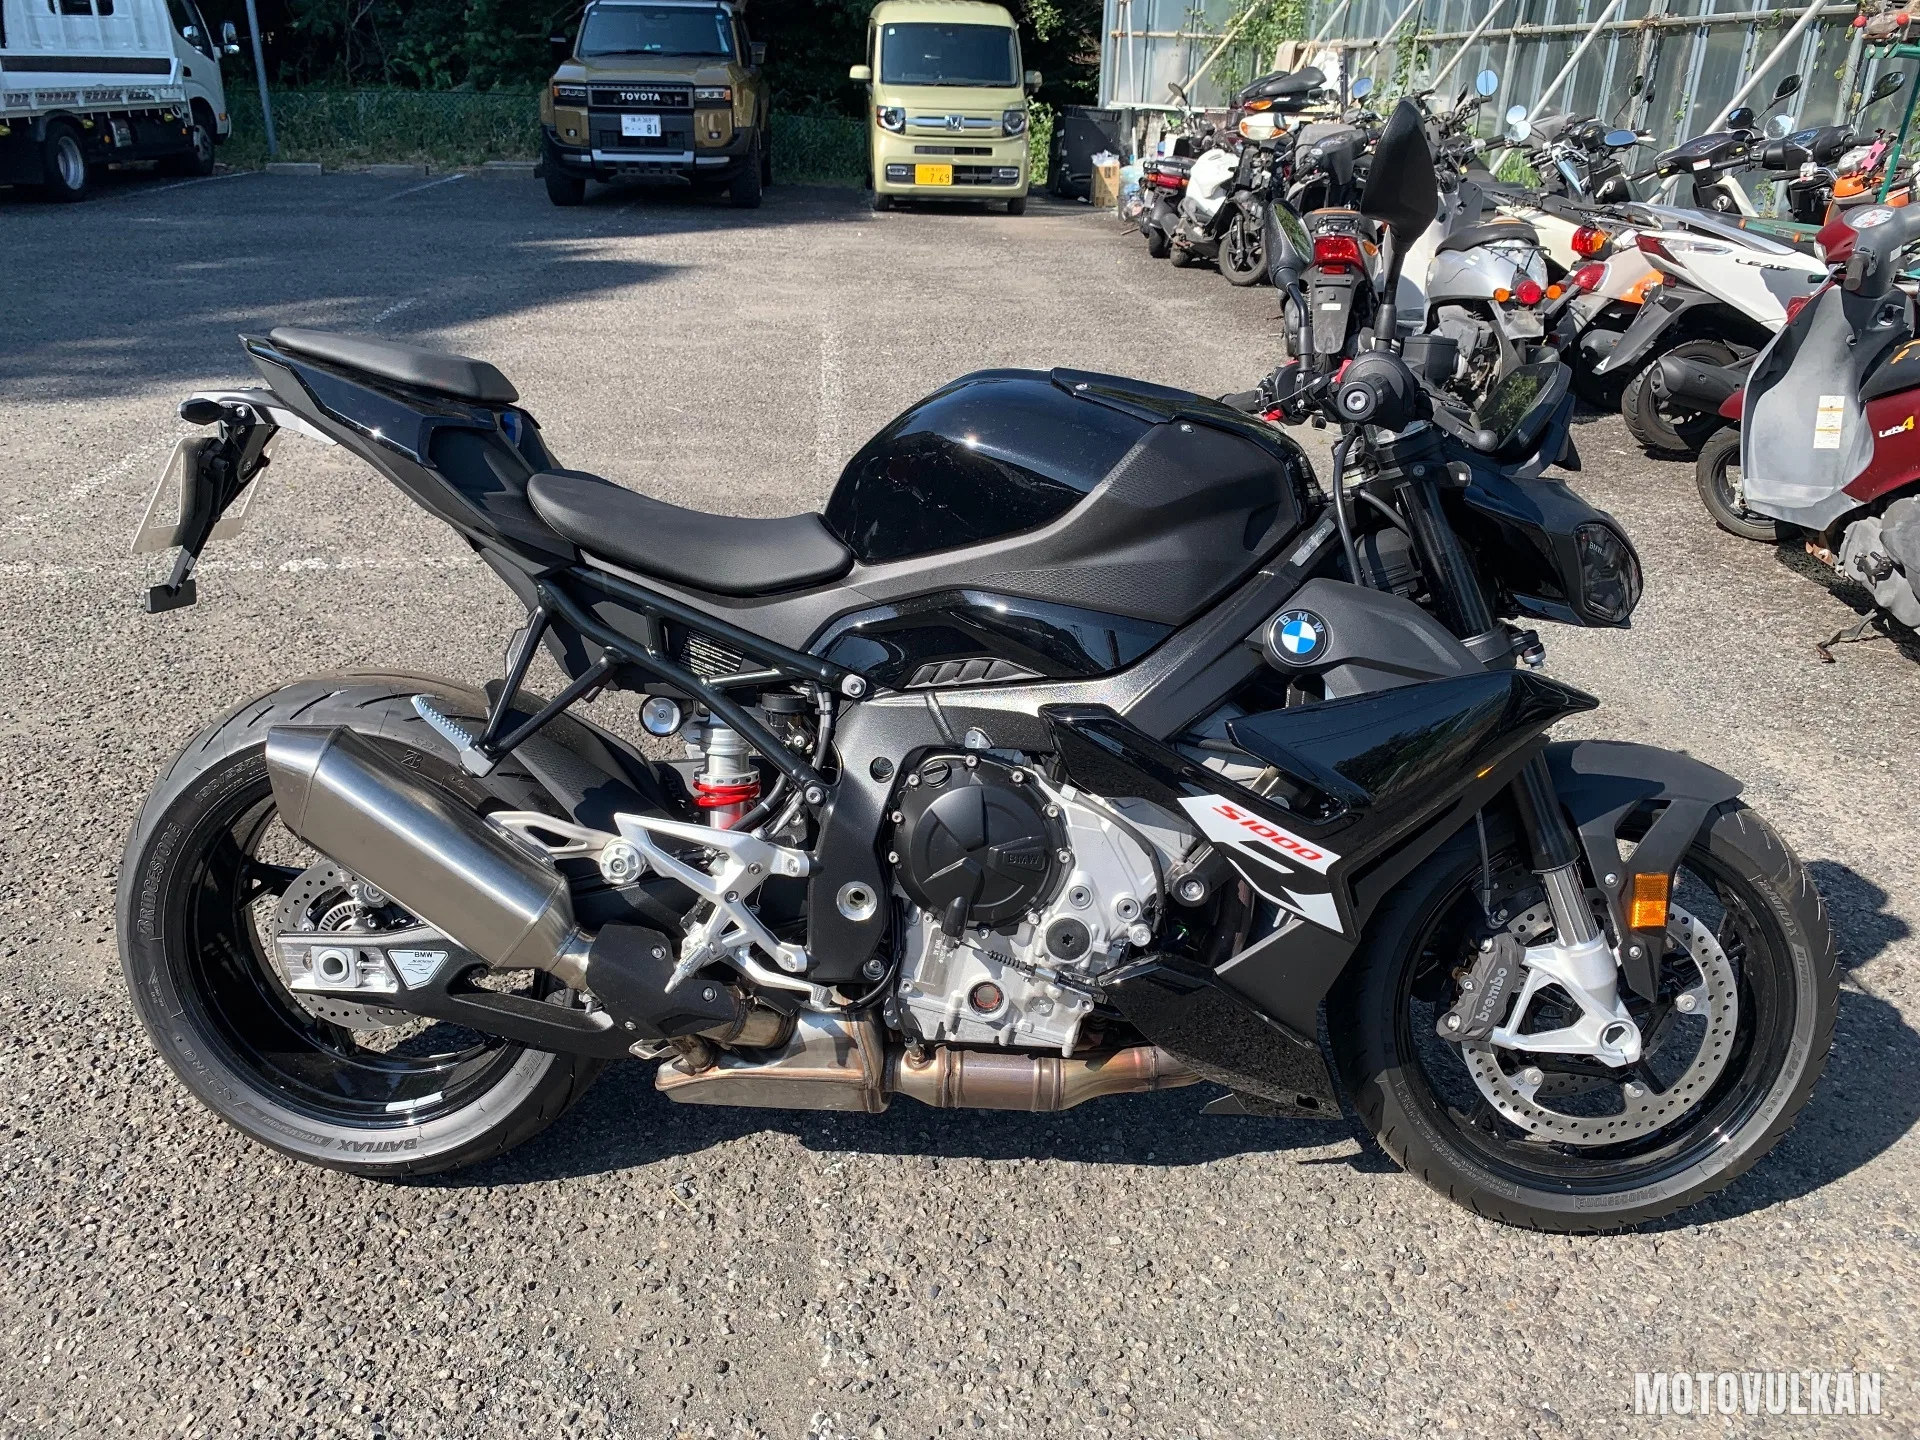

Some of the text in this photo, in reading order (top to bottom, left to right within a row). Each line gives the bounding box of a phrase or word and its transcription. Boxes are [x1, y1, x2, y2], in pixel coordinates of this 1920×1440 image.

[620, 91, 660, 101] TOYOTA
[1588, 541, 1604, 556] BMW
[1279, 611, 1325, 634] BMW
[1211, 805, 1324, 860] S1000
[1008, 853, 1040, 866] BMW
[136, 821, 183, 937] BRIDGESTONE
[1475, 967, 1508, 1022] brembo
[339, 1137, 419, 1154] BATTLAX
